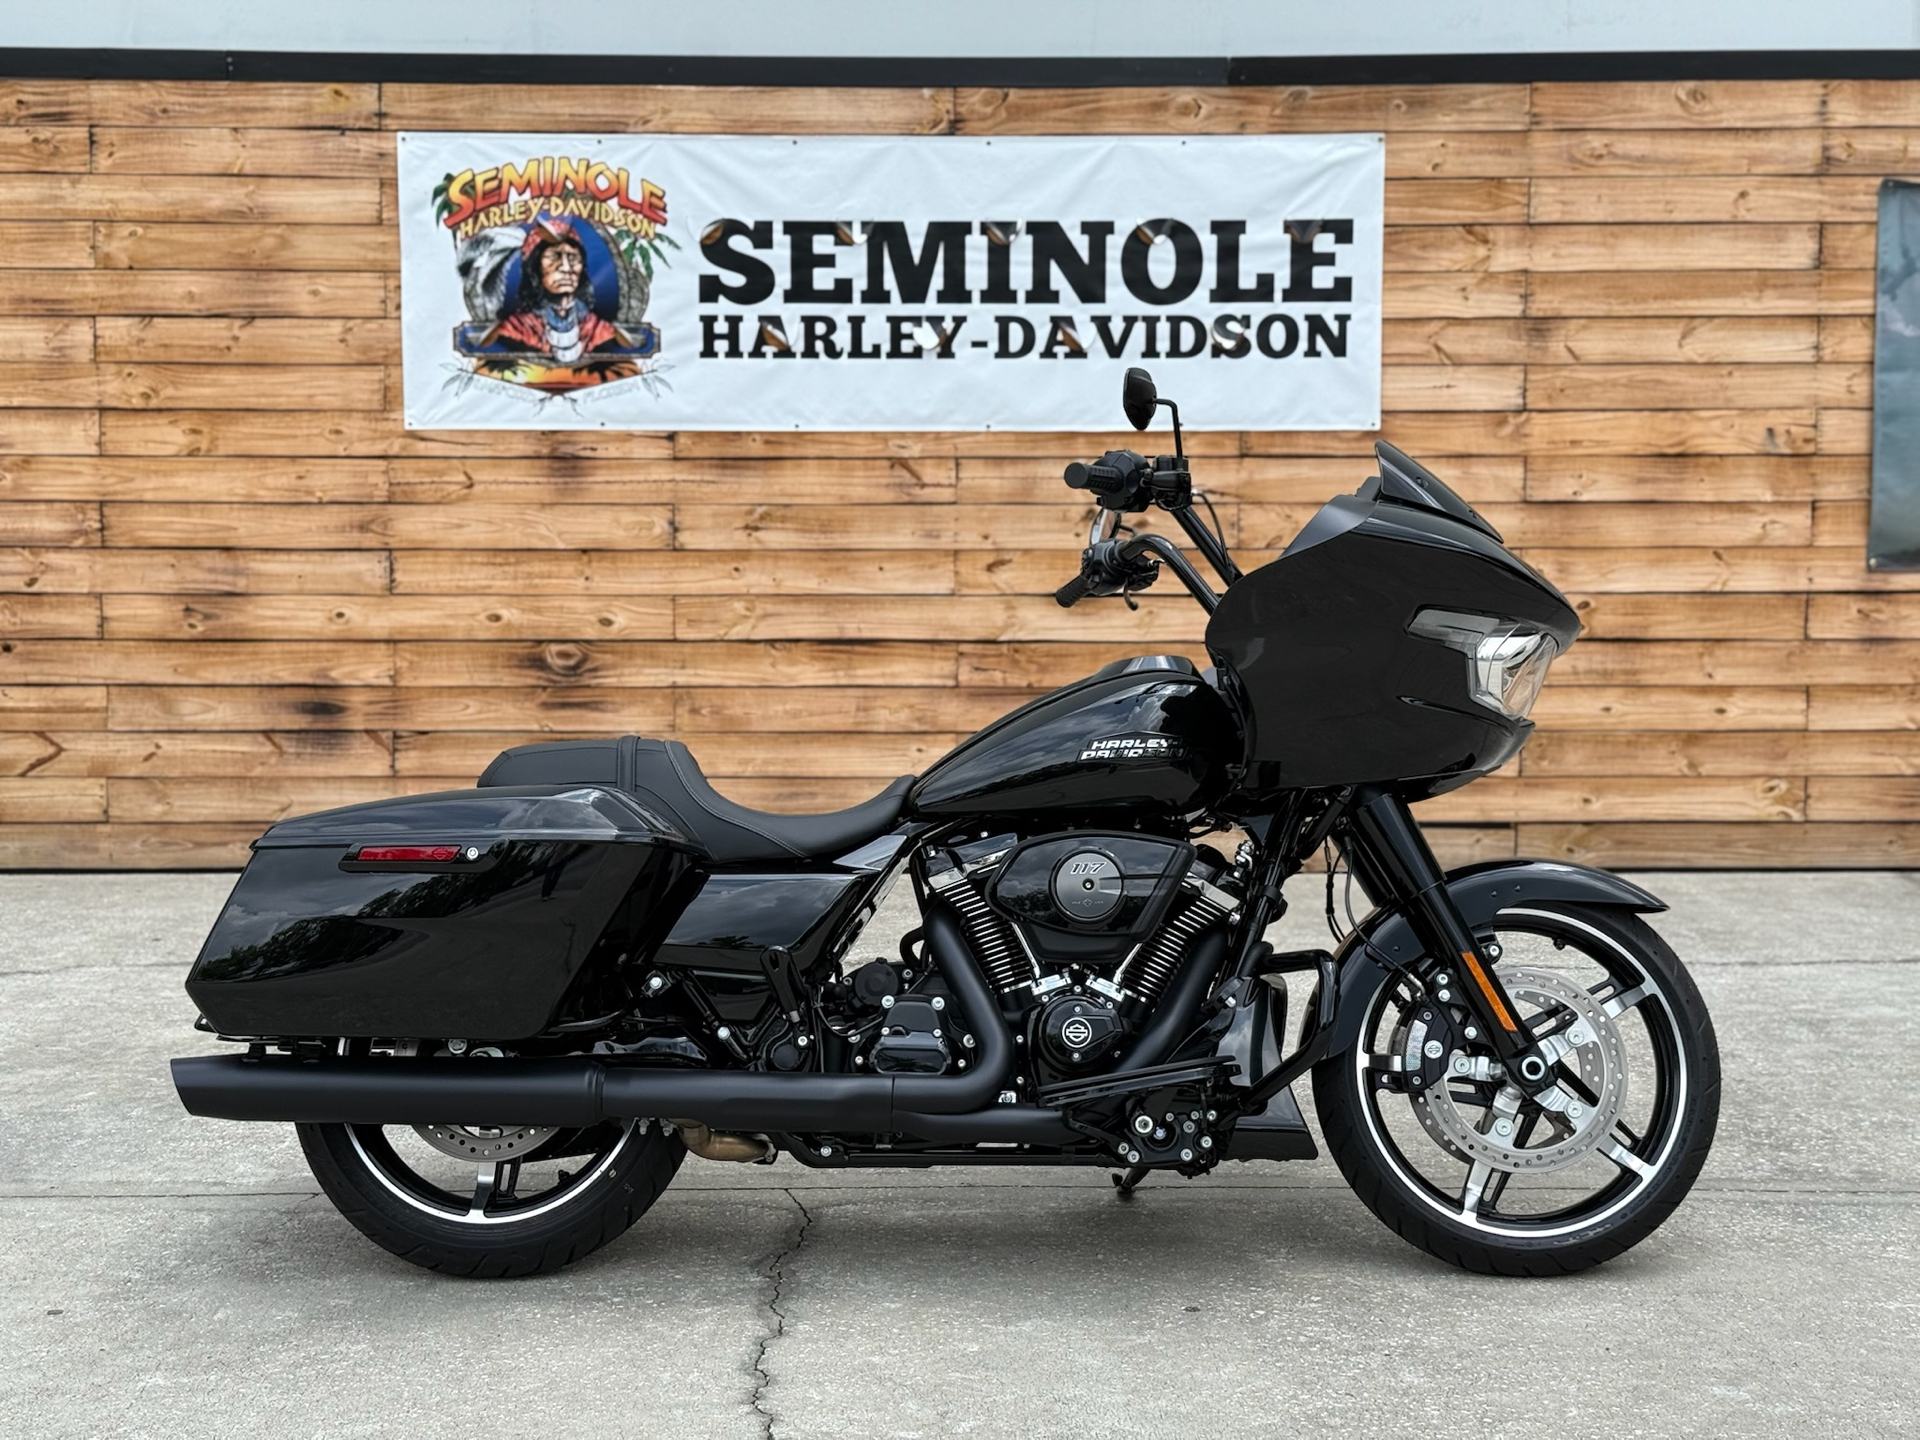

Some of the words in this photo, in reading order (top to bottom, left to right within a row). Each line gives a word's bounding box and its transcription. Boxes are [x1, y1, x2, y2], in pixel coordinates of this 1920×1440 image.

[443, 156, 668, 228] SEMINOLE
[460, 196, 658, 239] HARLEY-DAVIDSON
[699, 218, 1353, 305] SEMINOLE
[699, 313, 1351, 359] HARLEY-DAVIDSON
[1080, 748, 1183, 760] DAVIDSON
[1070, 861, 1107, 875] 117
